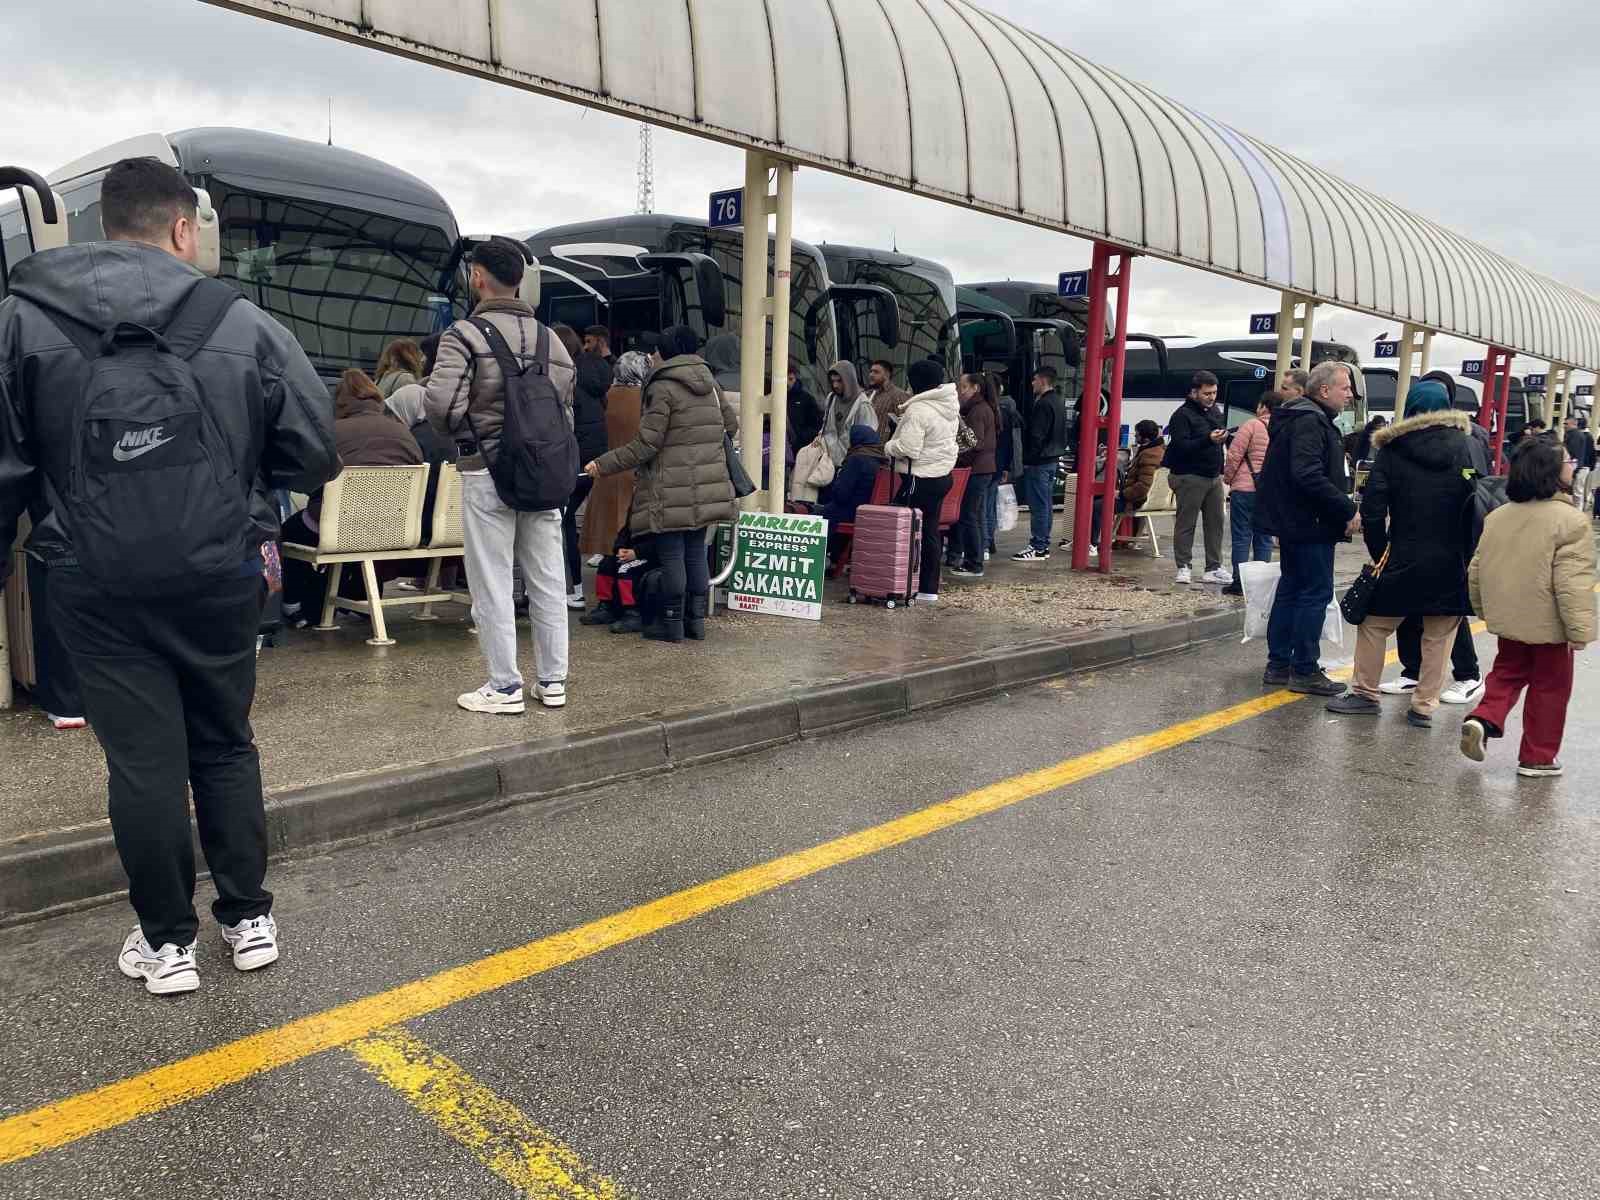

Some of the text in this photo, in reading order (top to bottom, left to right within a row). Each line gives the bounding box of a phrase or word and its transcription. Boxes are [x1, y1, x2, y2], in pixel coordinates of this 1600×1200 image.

[716, 197, 737, 221] 76
[1064, 276, 1082, 293] 77
[1256, 318, 1271, 330] 78
[1379, 344, 1394, 355] 79
[1465, 362, 1480, 372] 80
[120, 426, 164, 447] NIKE
[739, 530, 820, 546] OTOBANDAN
[749, 540, 808, 553] EXPRESS
[734, 570, 818, 600] SAKARYA
